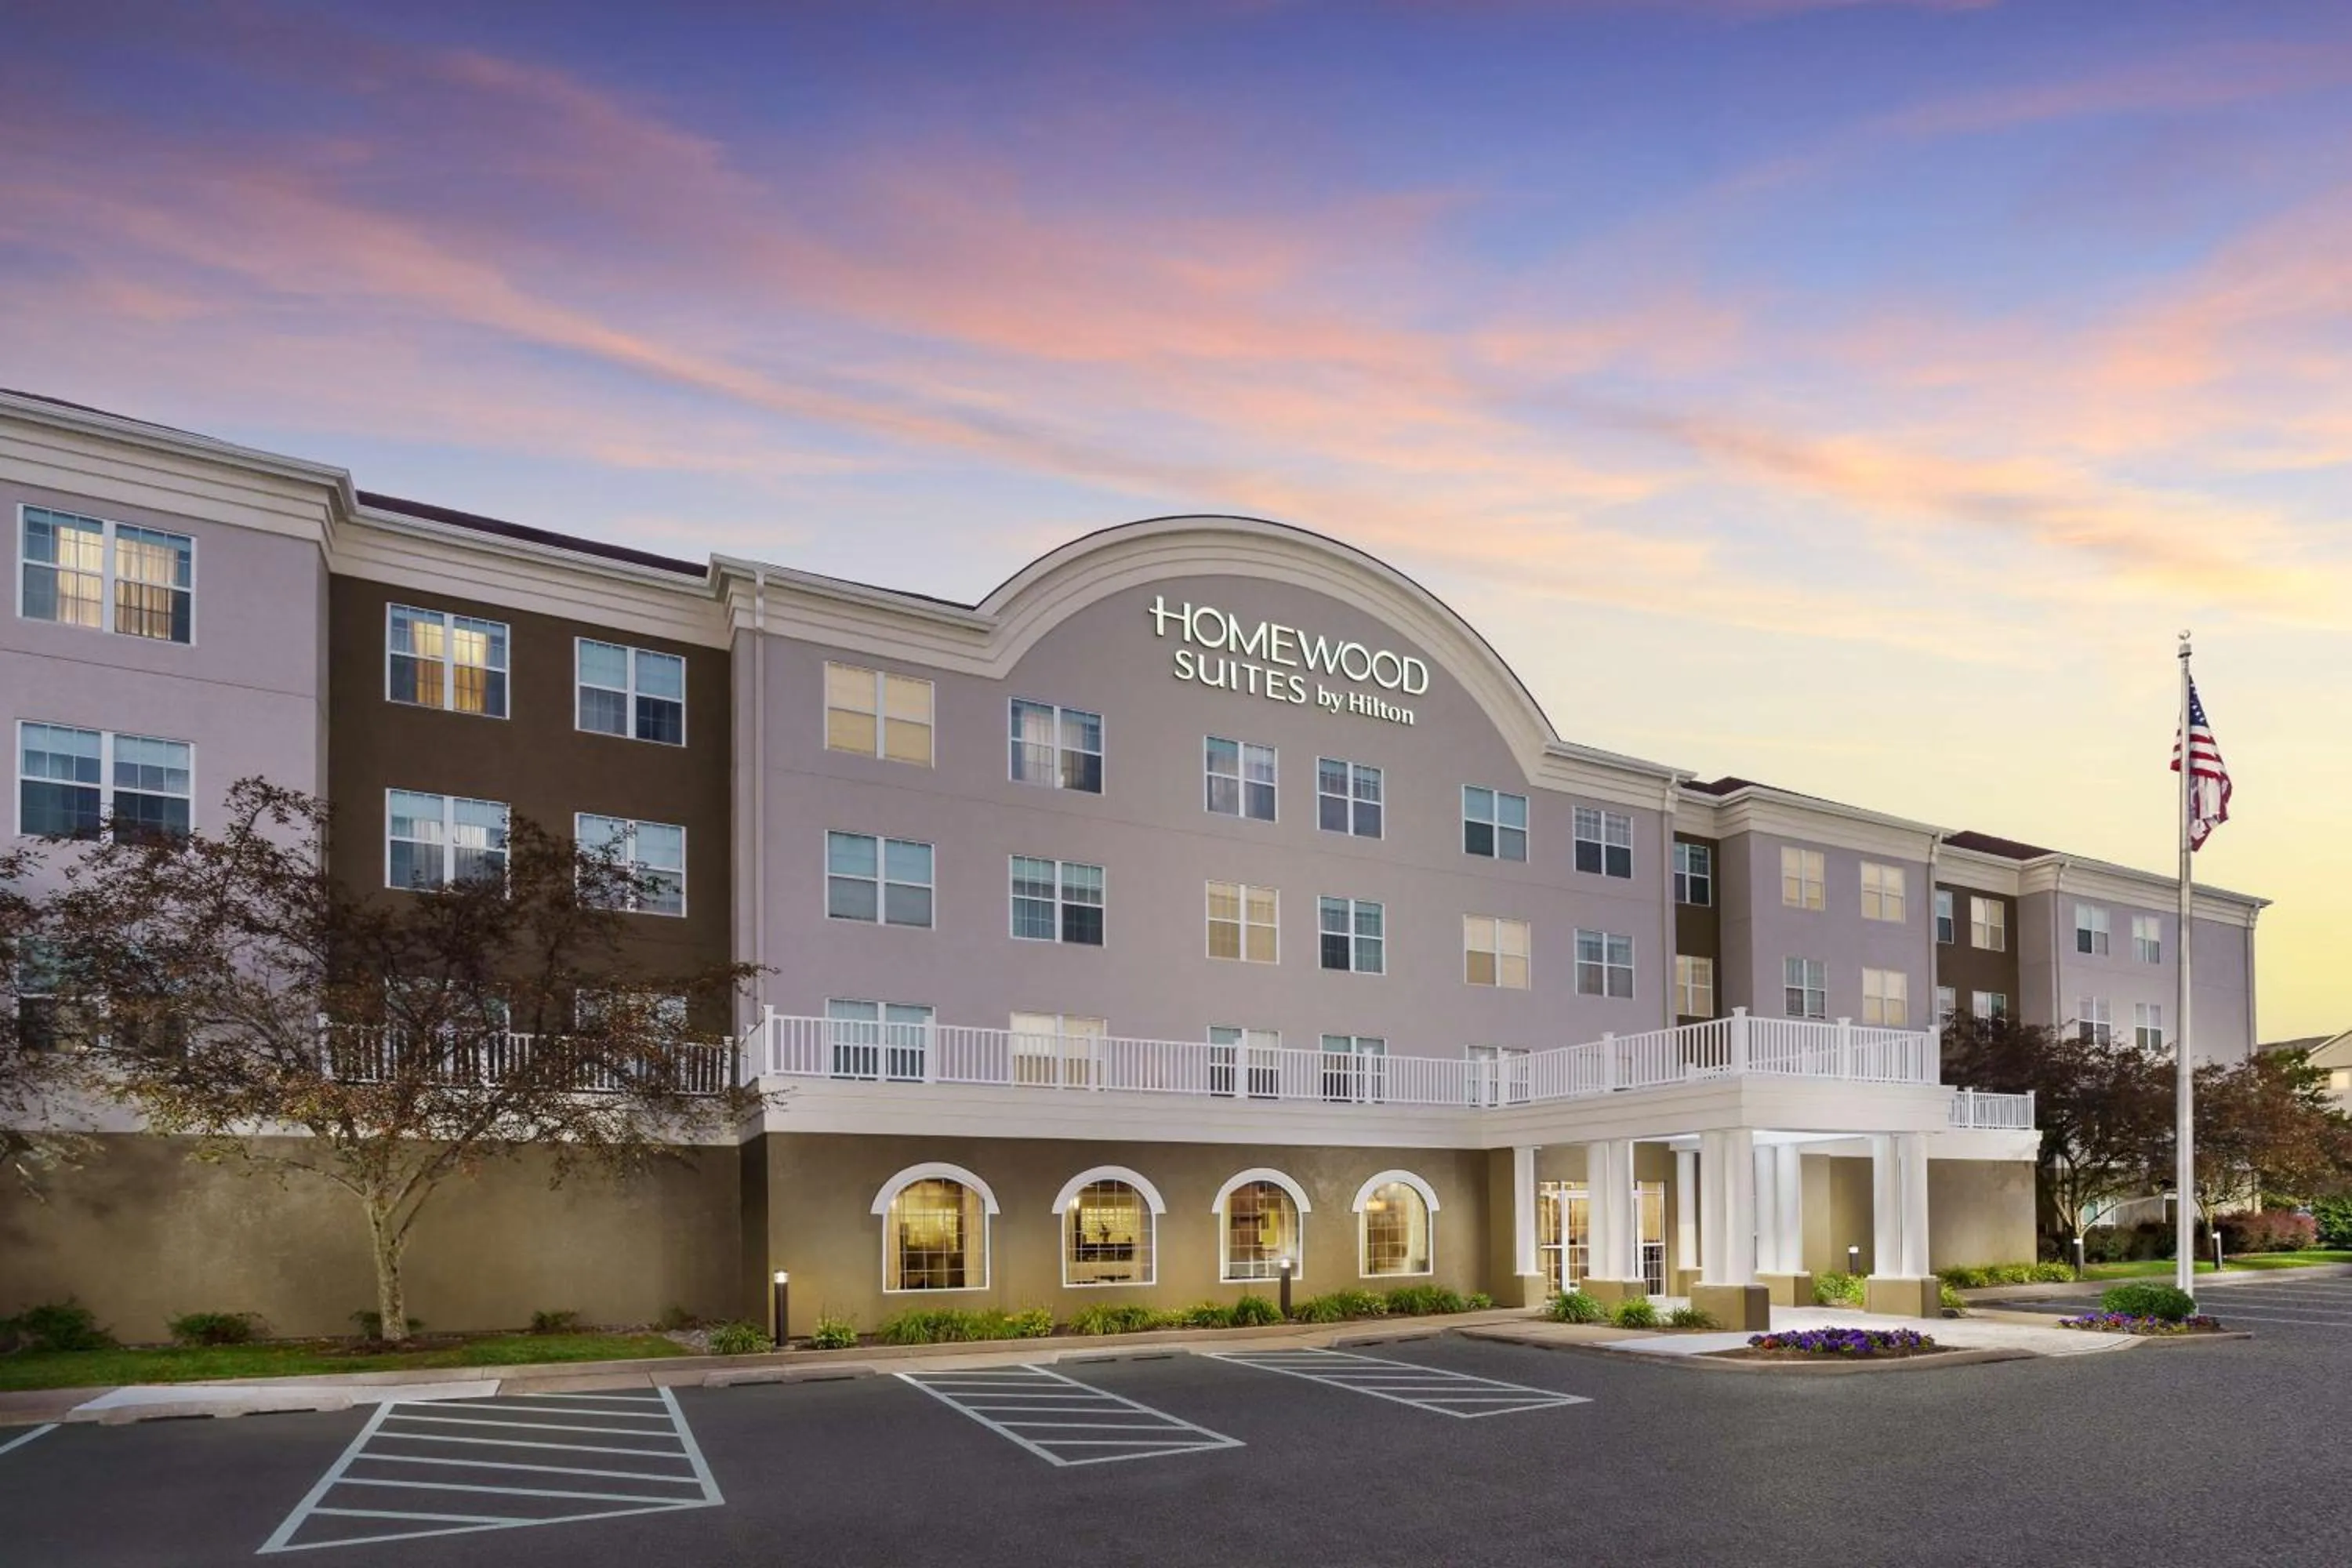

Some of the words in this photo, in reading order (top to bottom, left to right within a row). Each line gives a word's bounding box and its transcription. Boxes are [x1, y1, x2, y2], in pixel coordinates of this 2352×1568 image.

[1149, 596, 1429, 695] HOMEWOOD
[1174, 650, 1306, 703] SUITES
[1317, 684, 1342, 713] by
[1348, 691, 1414, 725] Hilton
